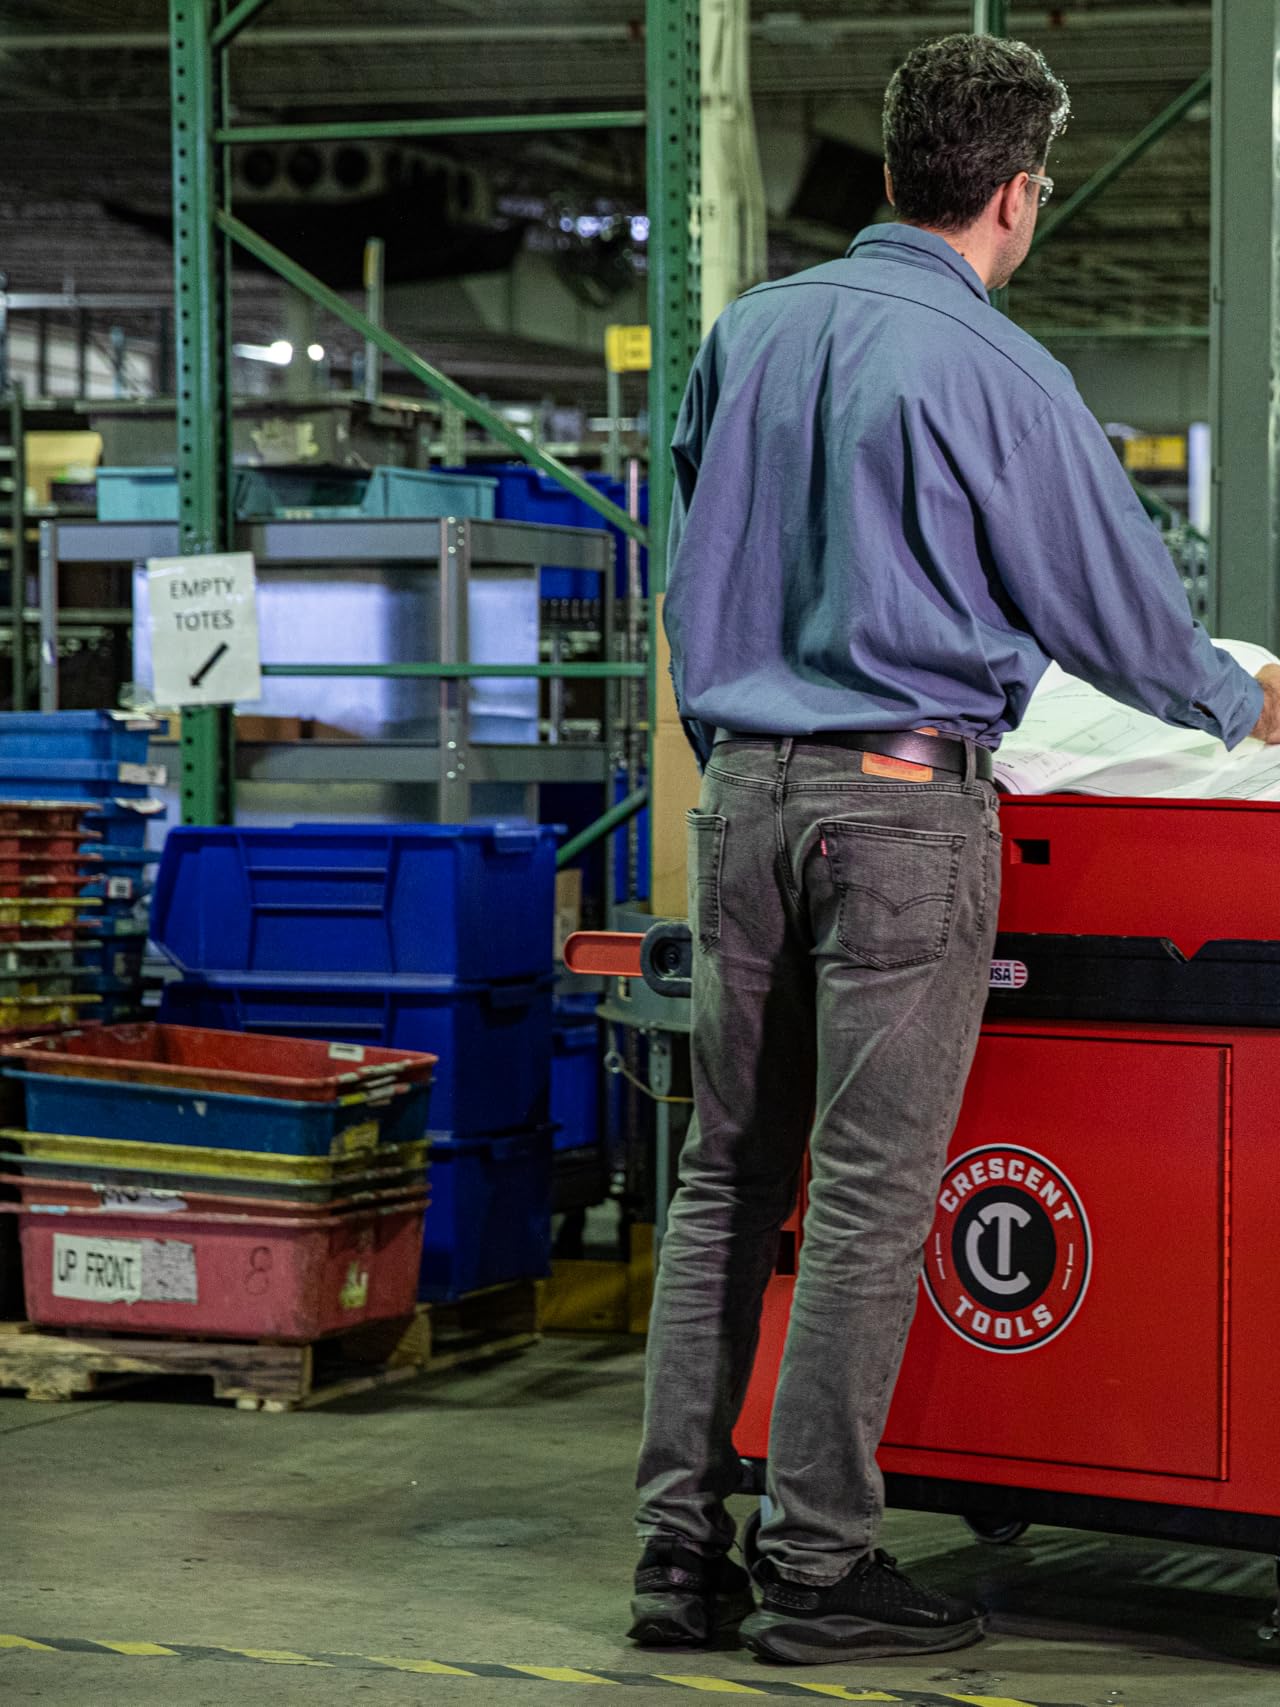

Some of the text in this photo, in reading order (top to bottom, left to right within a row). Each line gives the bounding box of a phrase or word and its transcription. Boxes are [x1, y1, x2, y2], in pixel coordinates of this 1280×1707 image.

[170, 576, 235, 599] EMPTY
[174, 609, 234, 631] TOTES
[939, 1158, 1074, 1221] CRESCENT
[57, 1249, 136, 1290] UP FRONT
[955, 1295, 1053, 1339] TOOLS
